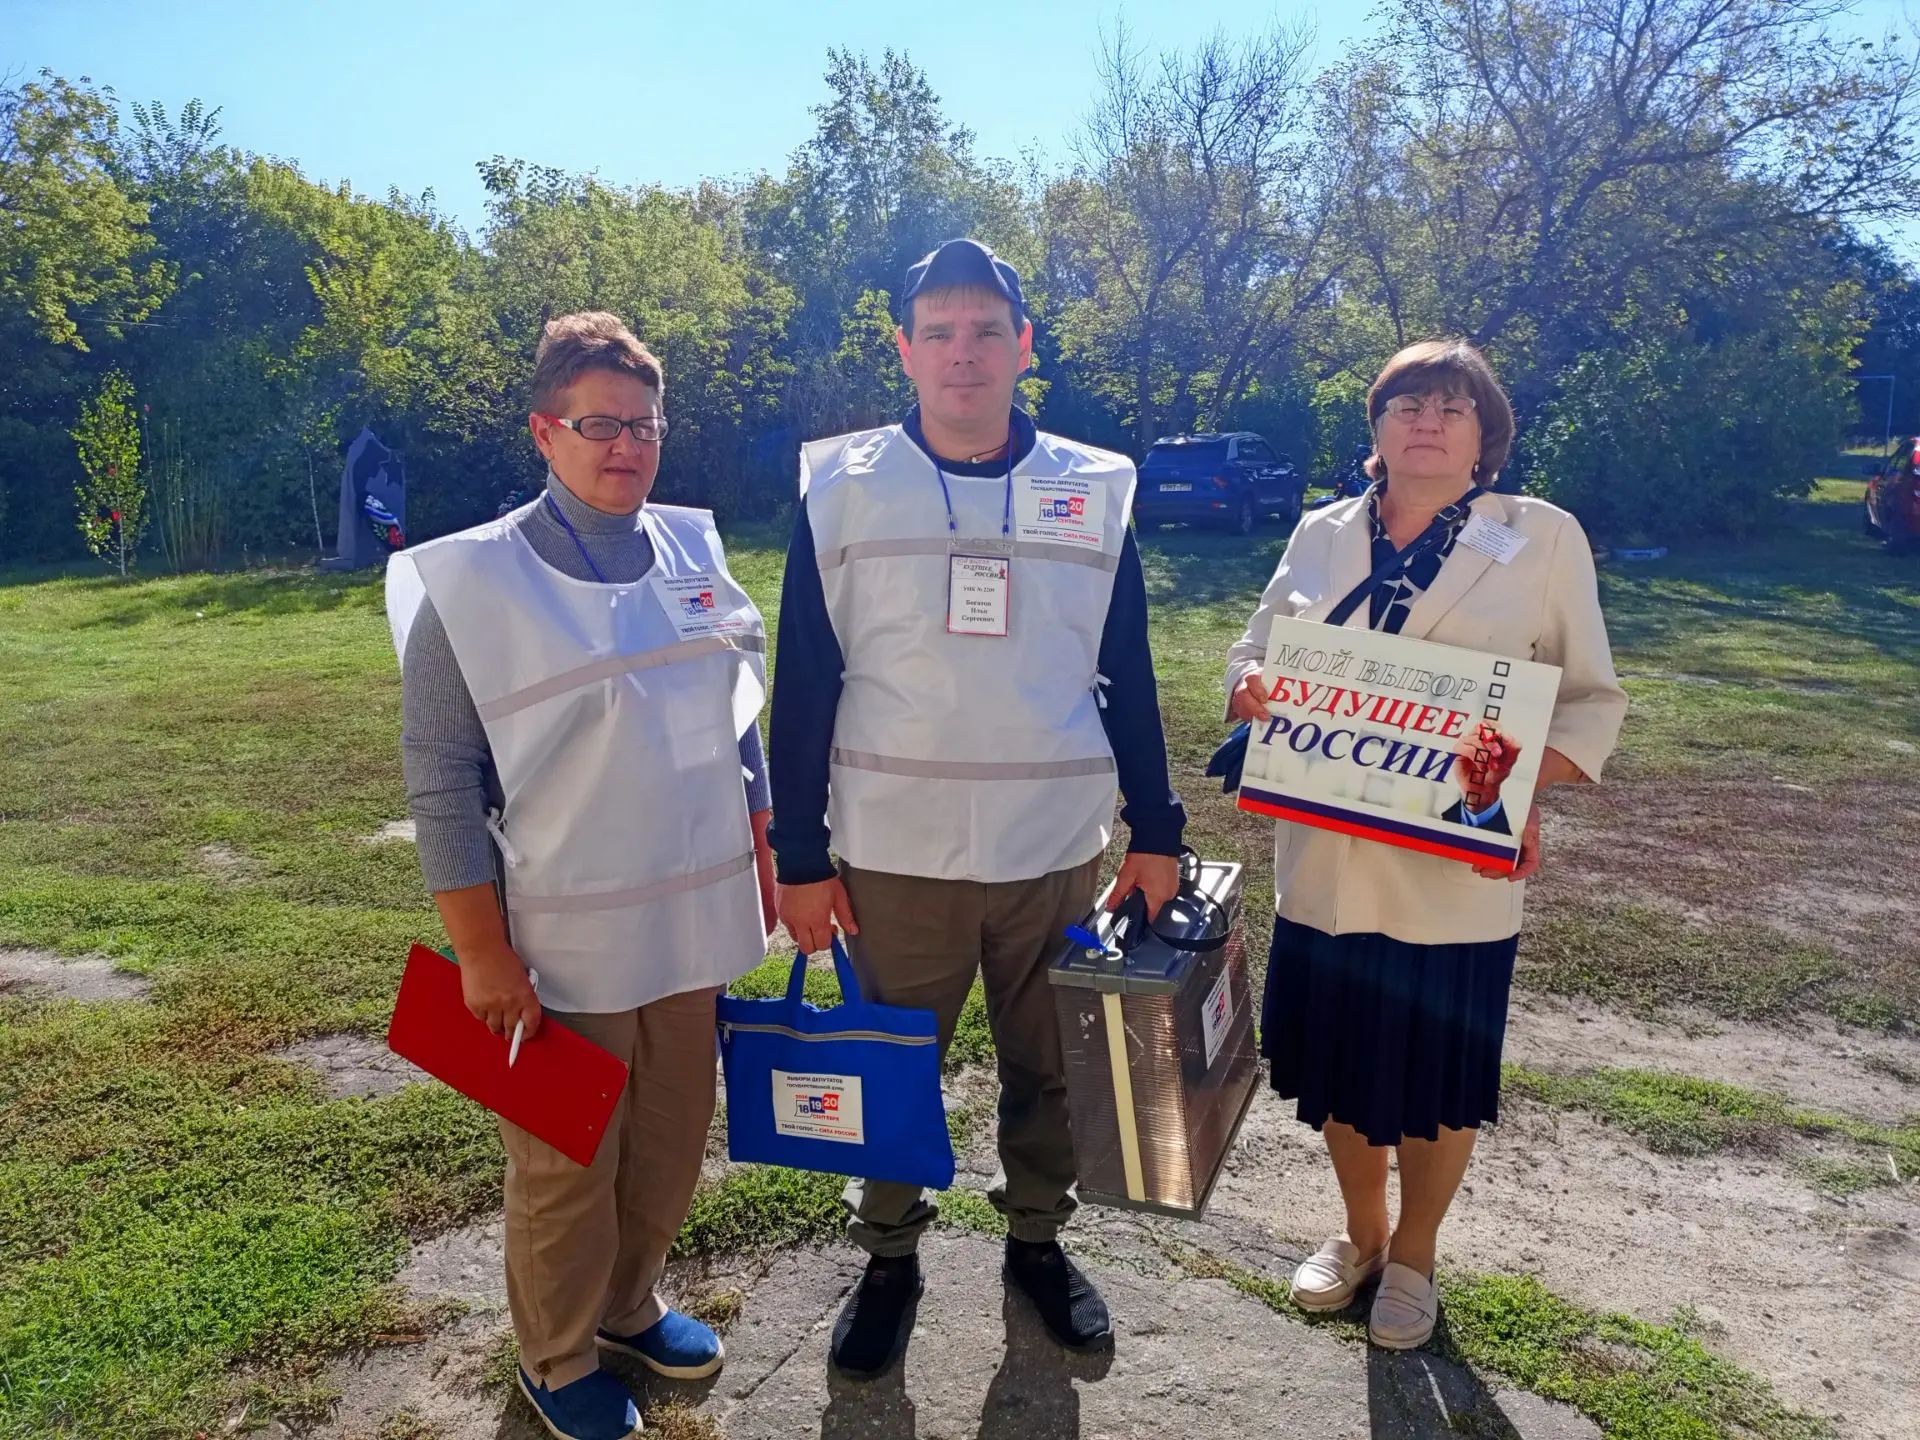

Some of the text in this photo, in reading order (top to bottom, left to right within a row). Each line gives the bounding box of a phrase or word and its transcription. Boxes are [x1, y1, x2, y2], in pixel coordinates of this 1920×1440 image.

[1057, 480, 1089, 488] ДЕПУТАТОВ
[1042, 500, 1082, 518] 18 19 20
[692, 601, 703, 611] 19
[700, 596, 712, 607] 20
[1273, 644, 1478, 701] МОЙ ВЫБОР
[1268, 675, 1470, 739] БУДУЩЕЕ
[1257, 715, 1461, 783] РОССИИ
[798, 1097, 837, 1114] 18 19 20
[796, 1124, 814, 1132] ГОЛОС
